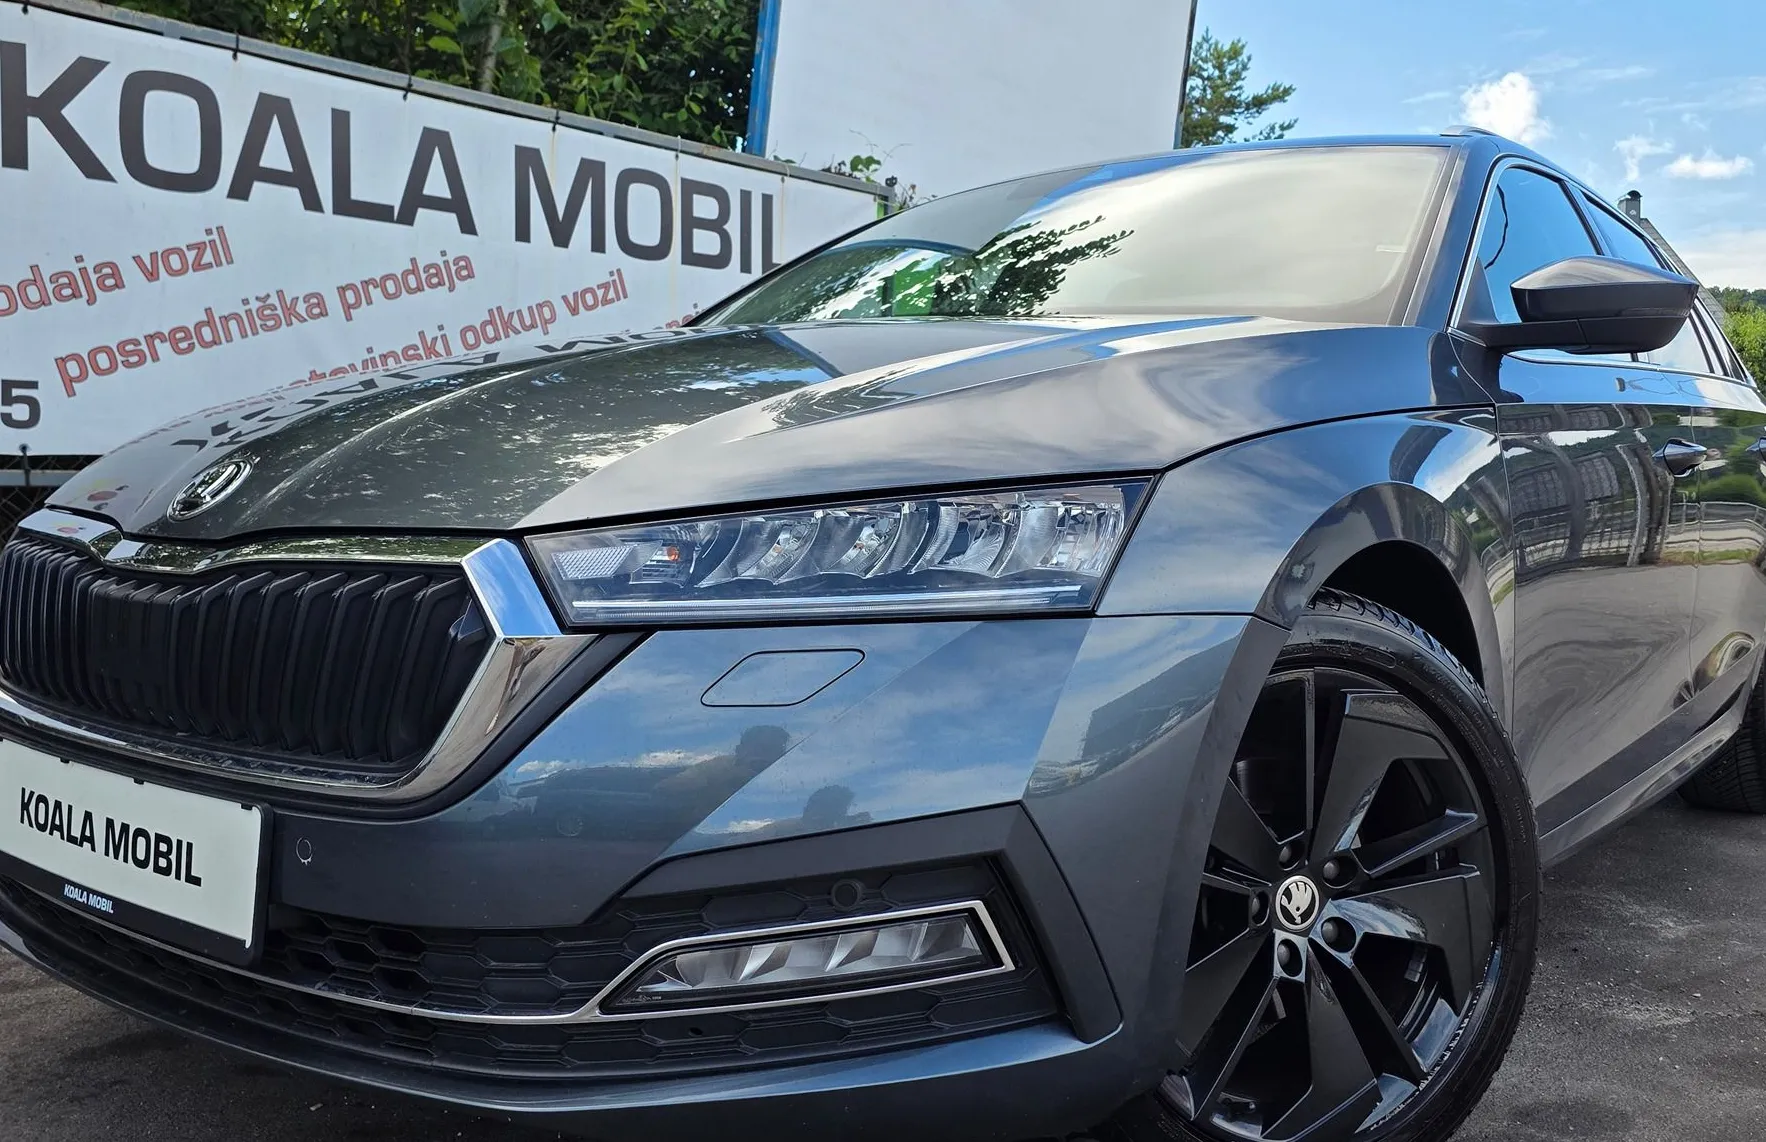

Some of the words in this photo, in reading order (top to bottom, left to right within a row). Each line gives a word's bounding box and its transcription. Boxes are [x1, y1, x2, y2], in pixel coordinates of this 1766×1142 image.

[0, 41, 479, 236] KOALA
[515, 145, 781, 275] MOBIL
[132, 226, 234, 282] vozil
[54, 289, 328, 398] posredniška
[337, 250, 476, 321] prodaja
[460, 299, 556, 350] odkup
[561, 268, 628, 316] vozil
[0, 379, 41, 429] 5
[20, 787, 96, 853] KOALA
[104, 817, 202, 887] MOBIL
[64, 884, 87, 904] KOALA
[88, 892, 114, 914] MOBIL
